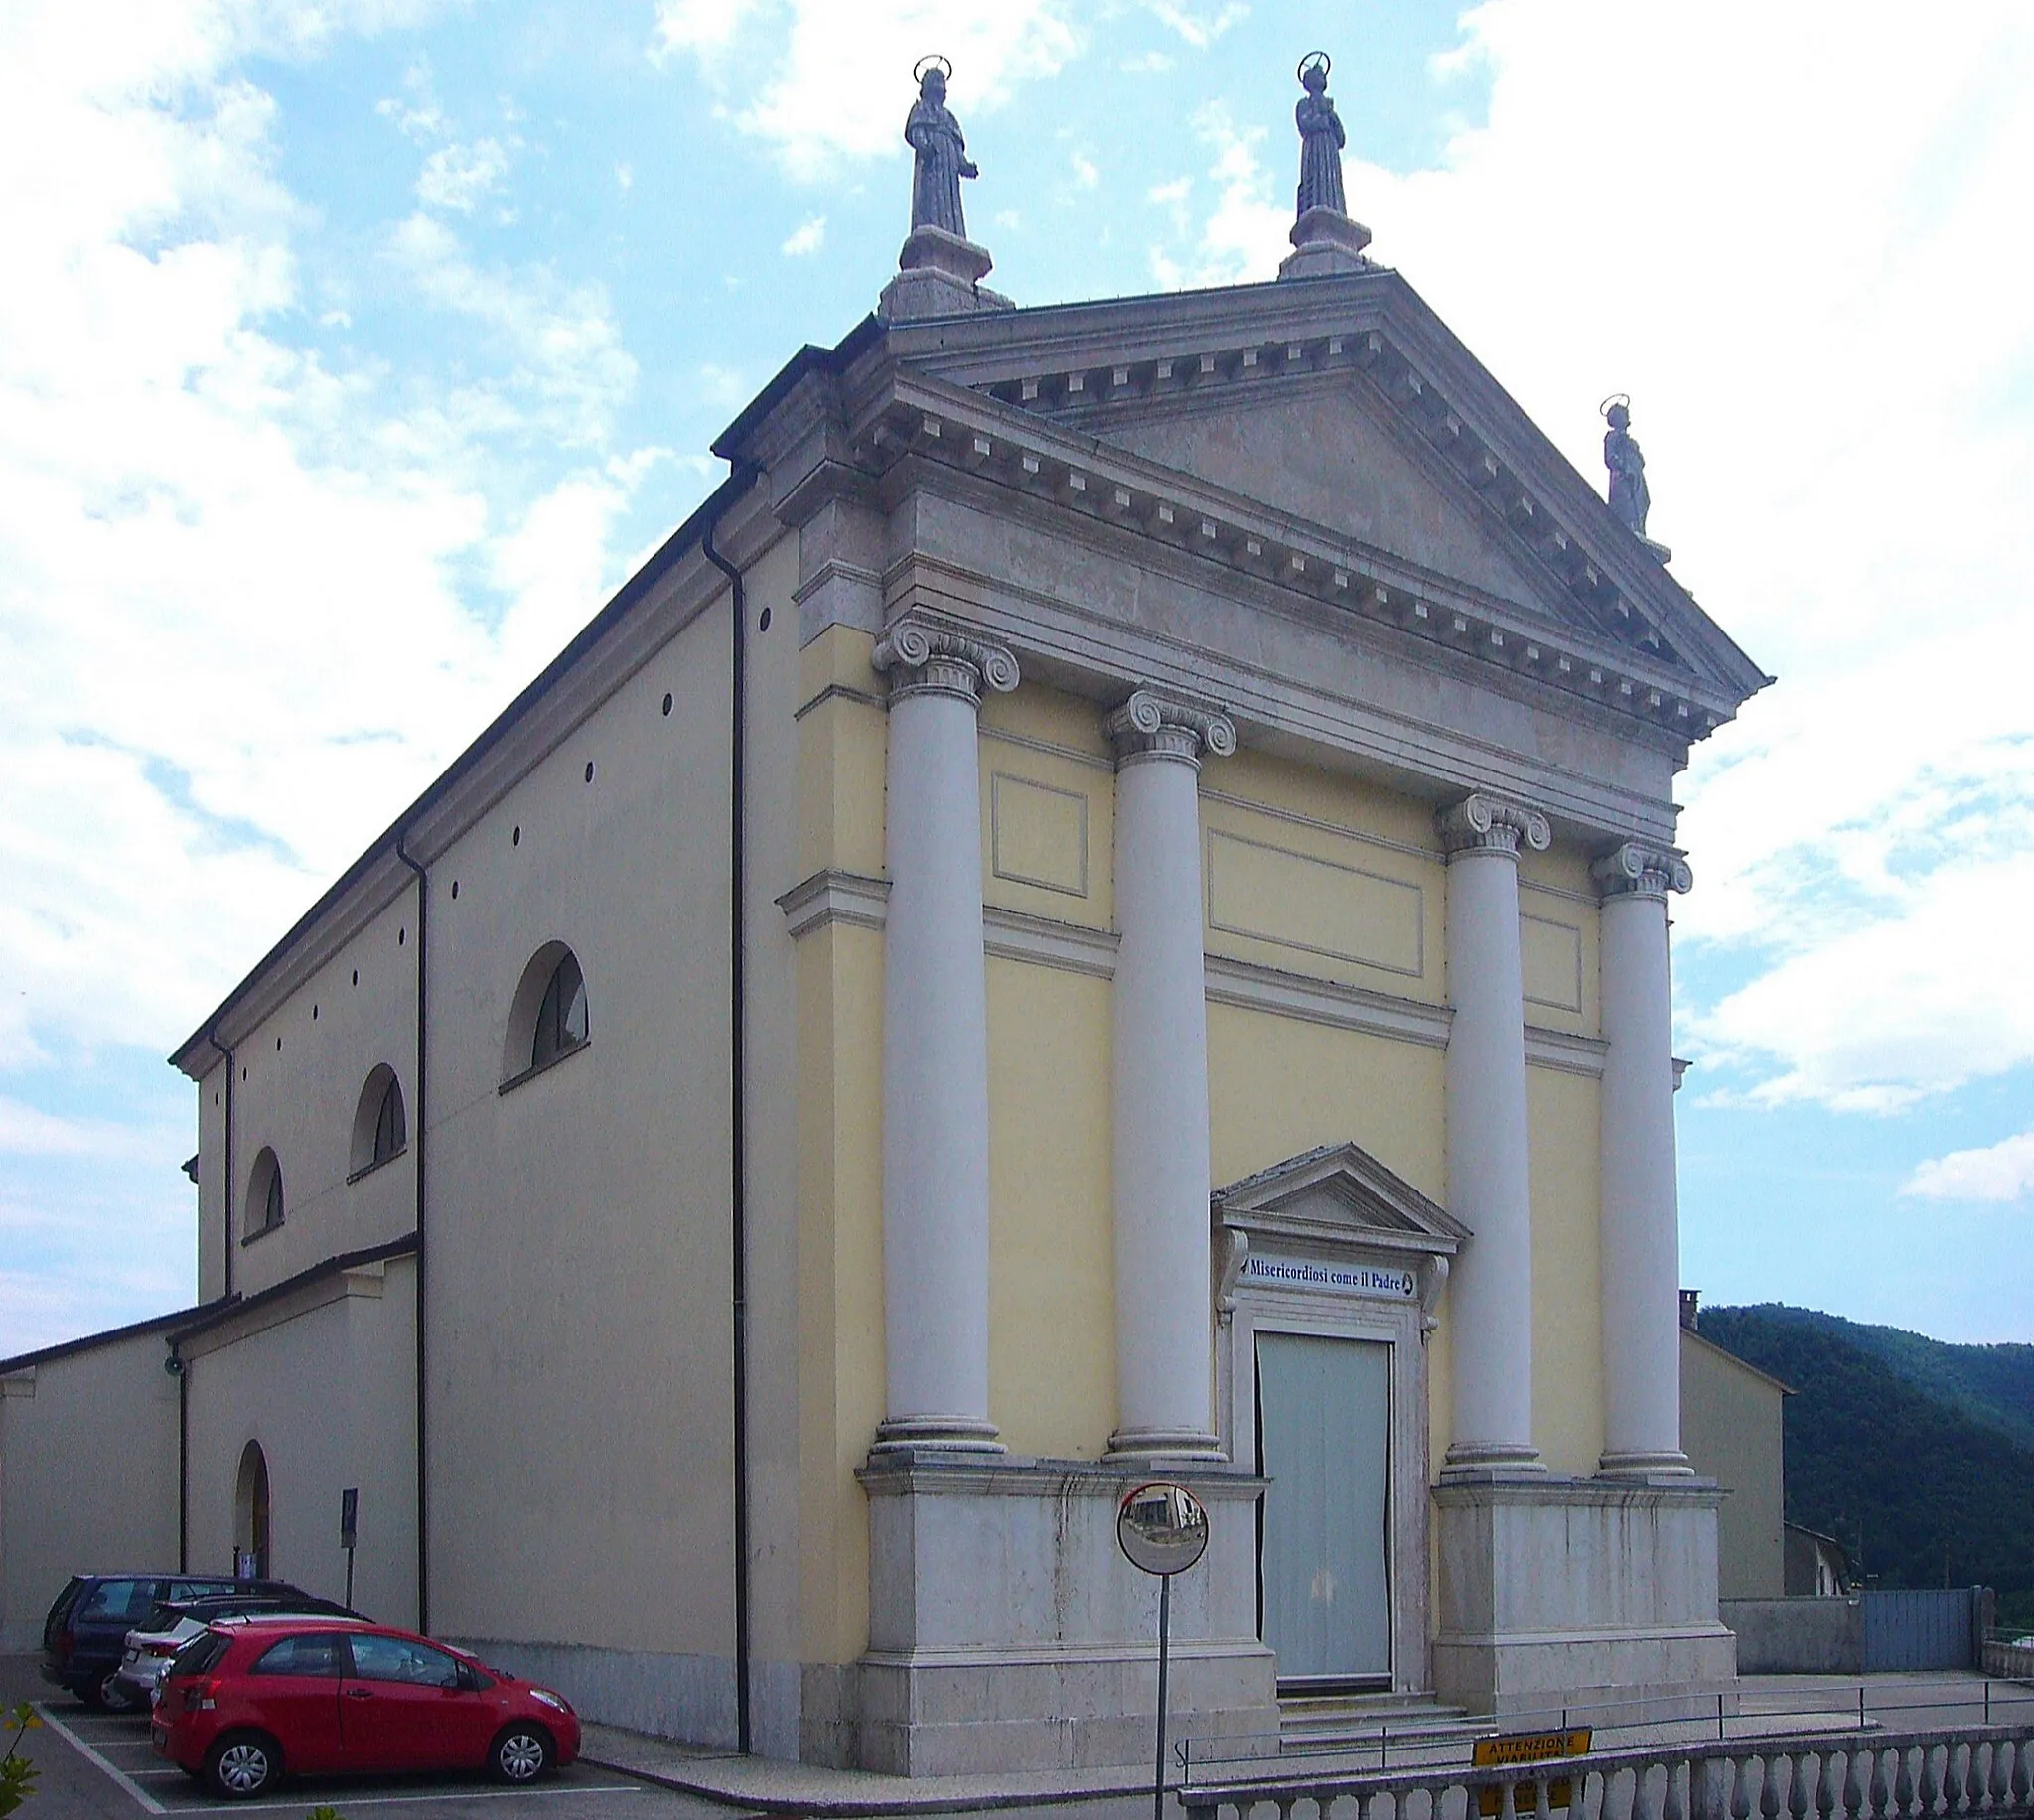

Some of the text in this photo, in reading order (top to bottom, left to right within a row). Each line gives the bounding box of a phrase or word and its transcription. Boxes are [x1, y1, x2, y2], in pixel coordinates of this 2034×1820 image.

[1251, 1259, 1400, 1290] Misericordiosi come il Padre
[1490, 1736, 1574, 1754] ATTENZIONE
